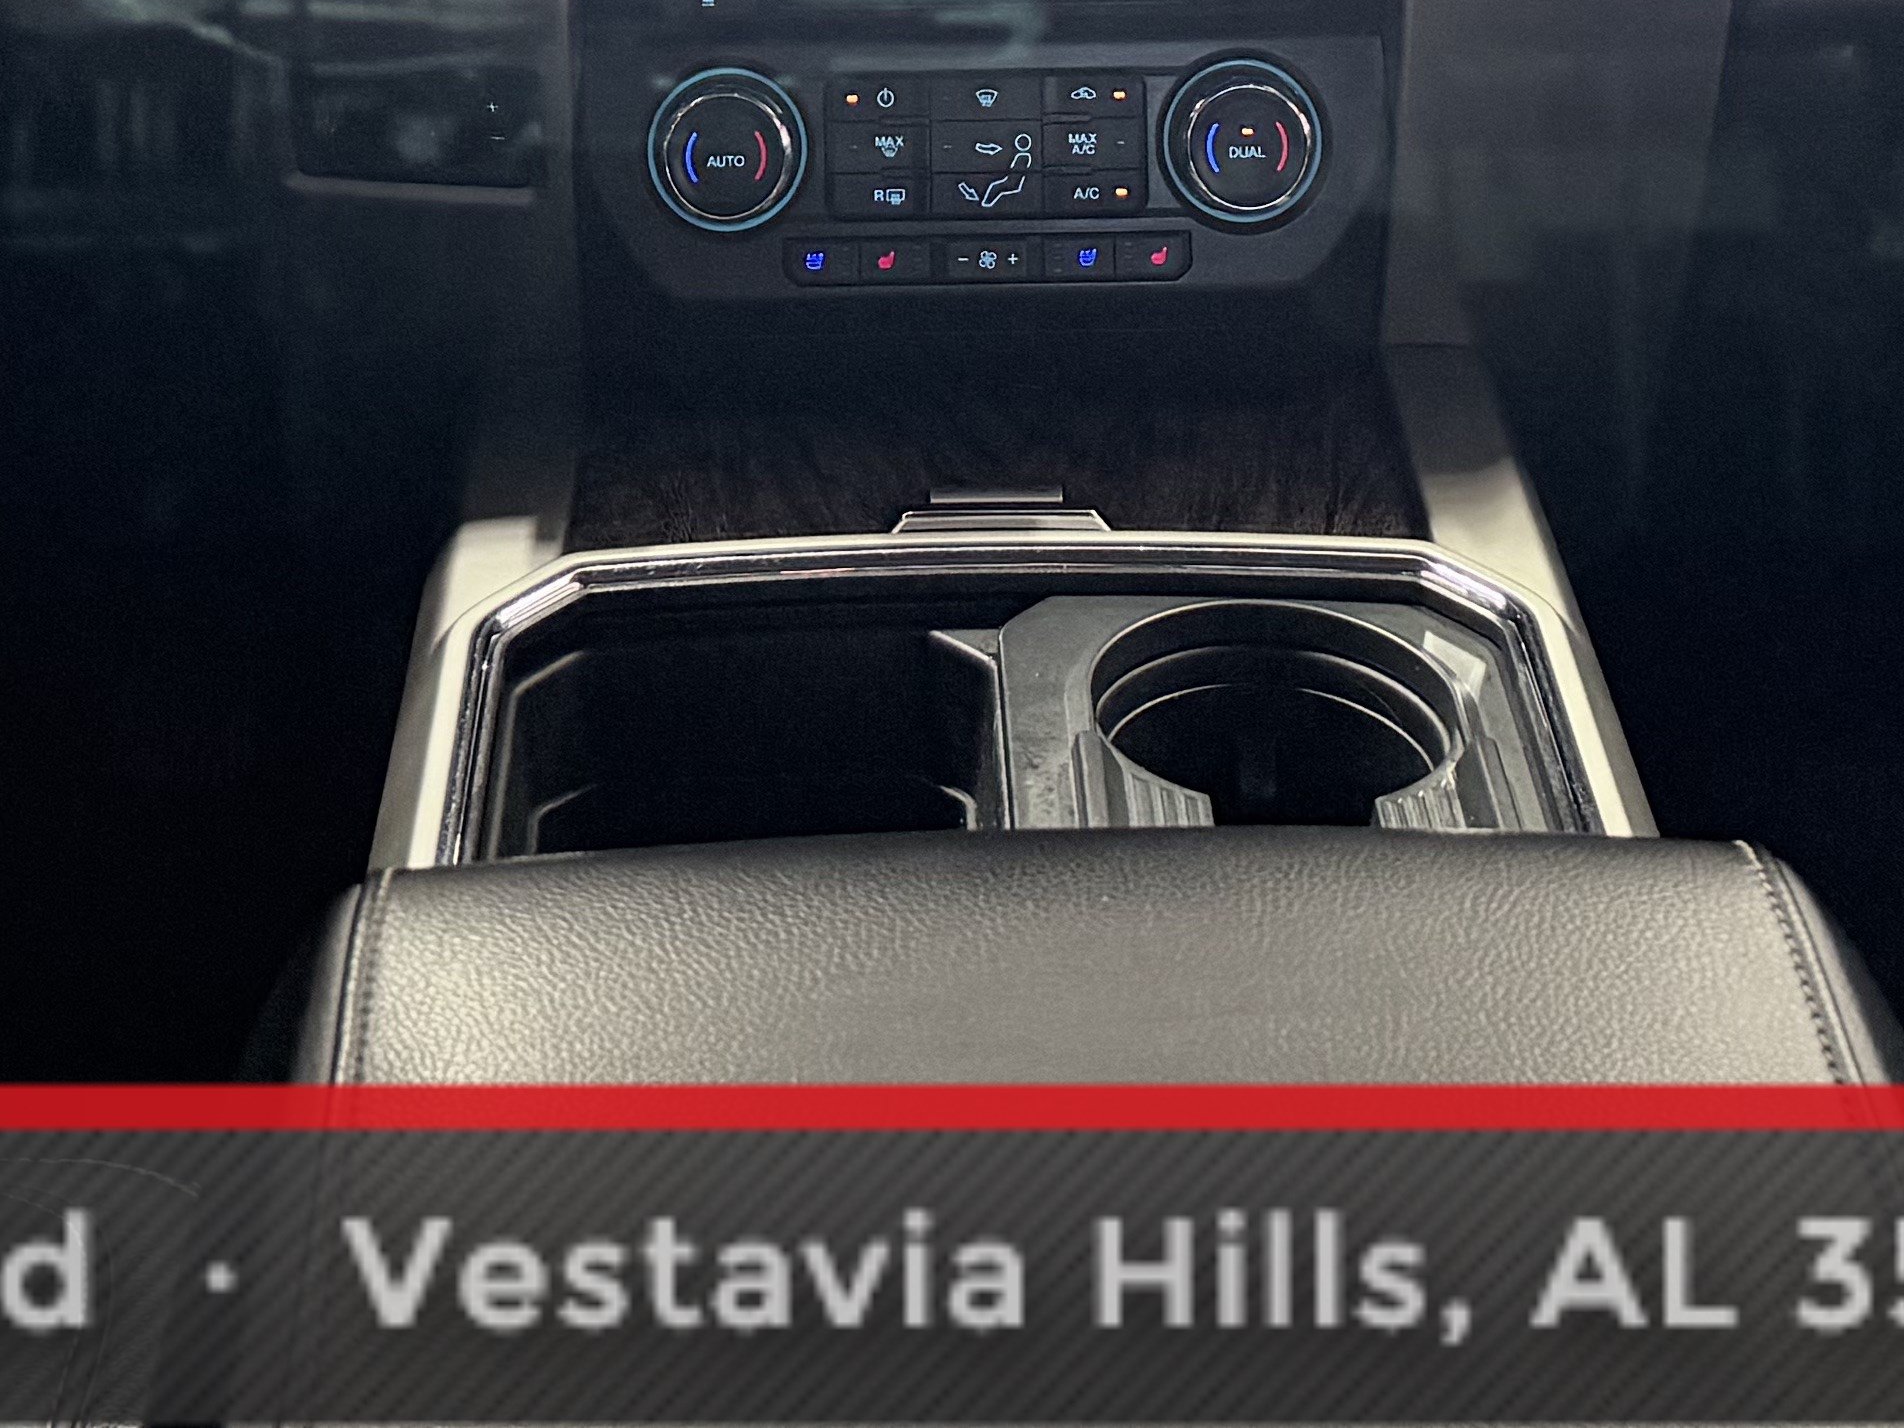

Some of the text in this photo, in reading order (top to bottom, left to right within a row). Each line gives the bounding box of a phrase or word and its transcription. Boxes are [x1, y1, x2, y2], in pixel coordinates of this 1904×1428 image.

[875, 135, 904, 148] MAX
[1068, 133, 1097, 145] MAX
[1072, 144, 1095, 155] A/C
[1228, 145, 1266, 160] DUAL
[706, 154, 745, 169] AUTO
[1073, 188, 1100, 200] A/C
